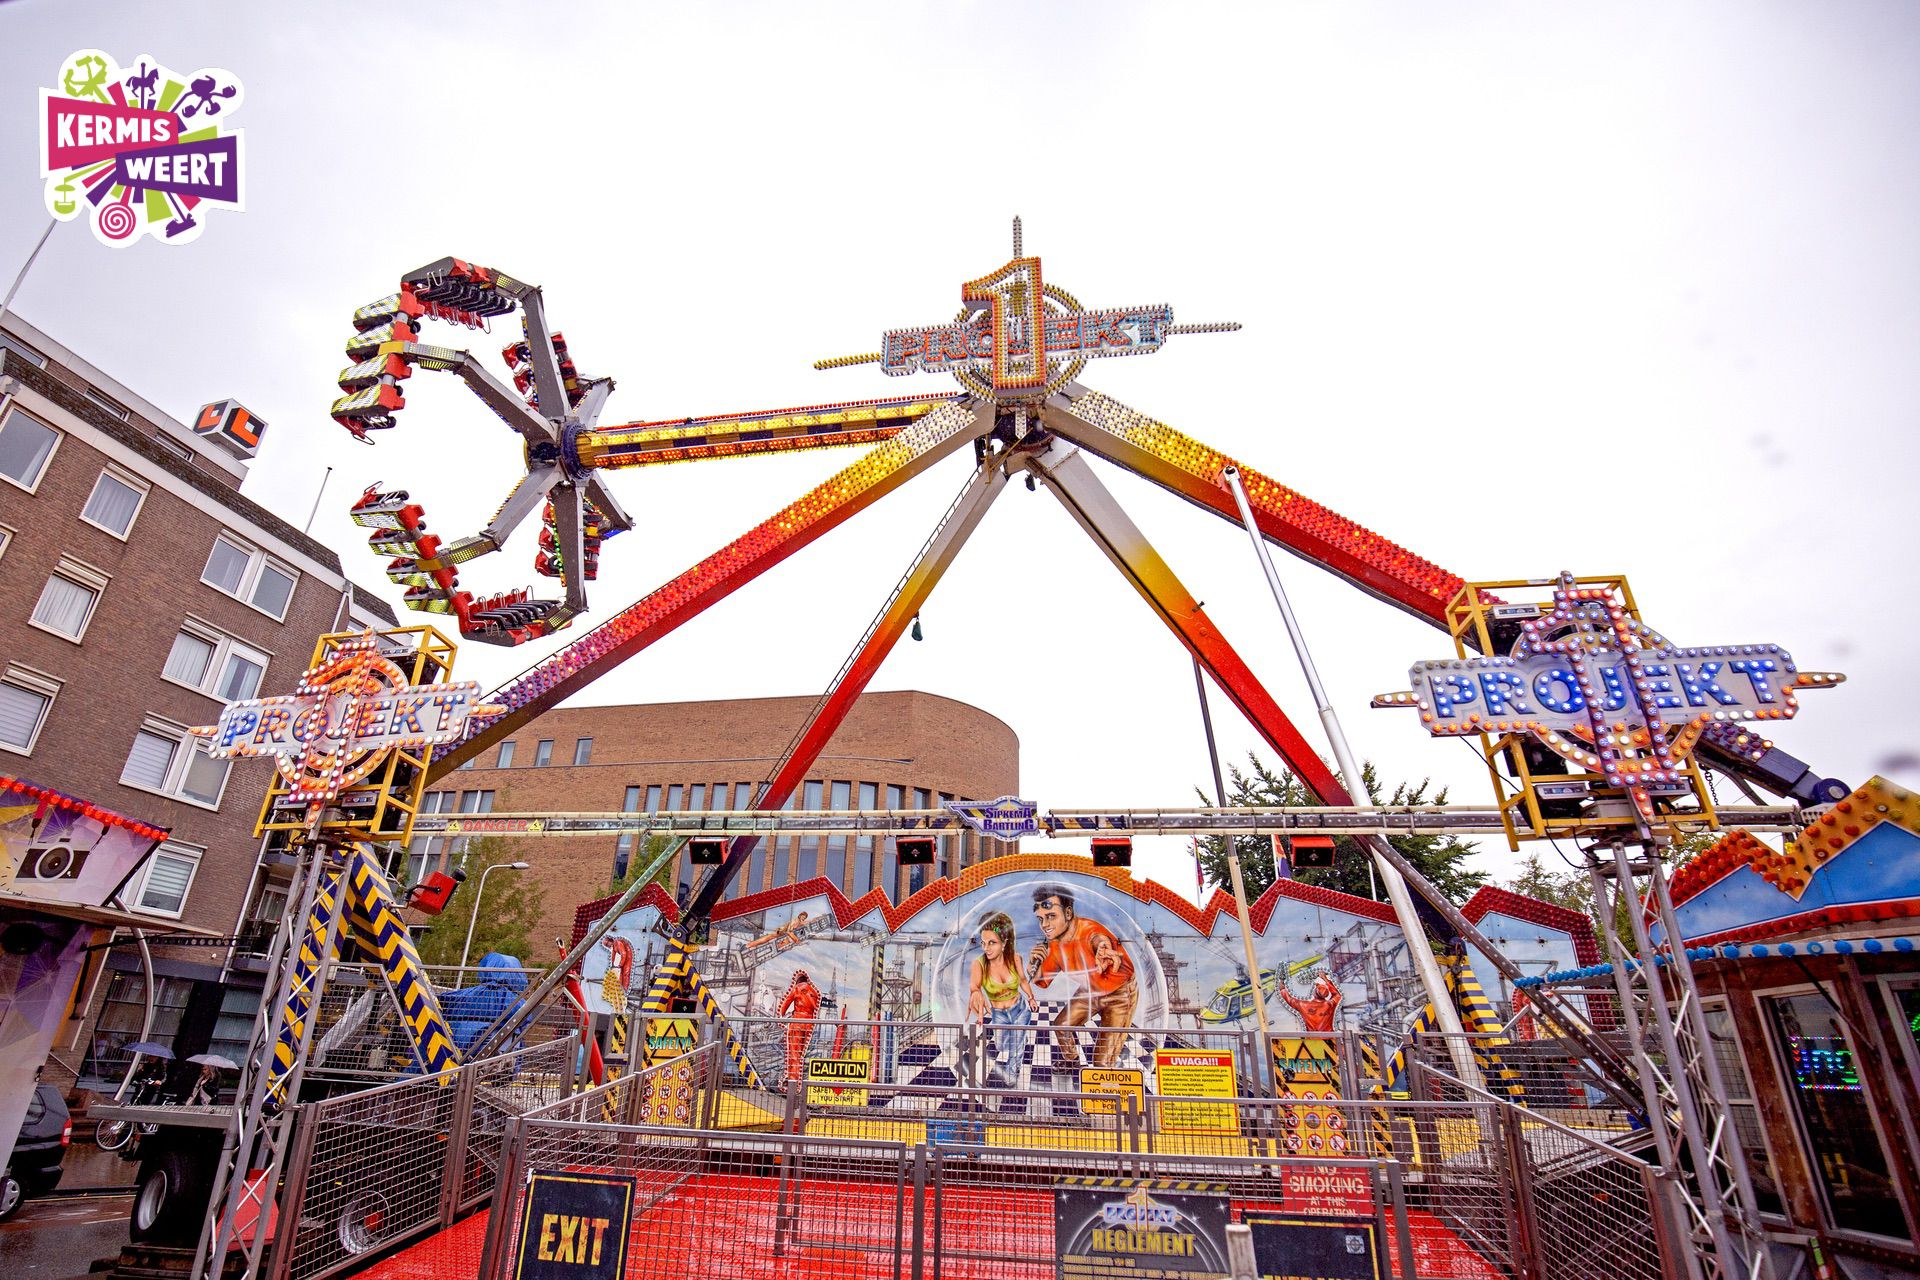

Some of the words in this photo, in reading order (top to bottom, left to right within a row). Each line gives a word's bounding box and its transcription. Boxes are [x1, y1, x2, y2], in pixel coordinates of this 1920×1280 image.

[888, 309, 1169, 367] PROJEKT
[1428, 658, 1778, 719] PROJEKT
[221, 694, 467, 747] PROJEKT
[463, 819, 528, 832] DANGER
[983, 818, 1034, 831] BARTLING
[648, 1035, 692, 1051] SAFETY!
[812, 1062, 865, 1076] CAUTION
[1170, 1057, 1218, 1066] UWAGA!!!
[1278, 1058, 1332, 1074] SAFETY!
[1091, 1072, 1132, 1082] CAUTION
[1101, 1088, 1136, 1096] SMOKING
[1289, 1175, 1365, 1195] SMOKING
[1327, 1196, 1347, 1207] THIS
[1106, 1206, 1175, 1223] PROJEKT
[1303, 1207, 1357, 1217] OPERATION
[537, 1213, 610, 1266] EXIT
[1092, 1228, 1197, 1257] REGLEMENT
